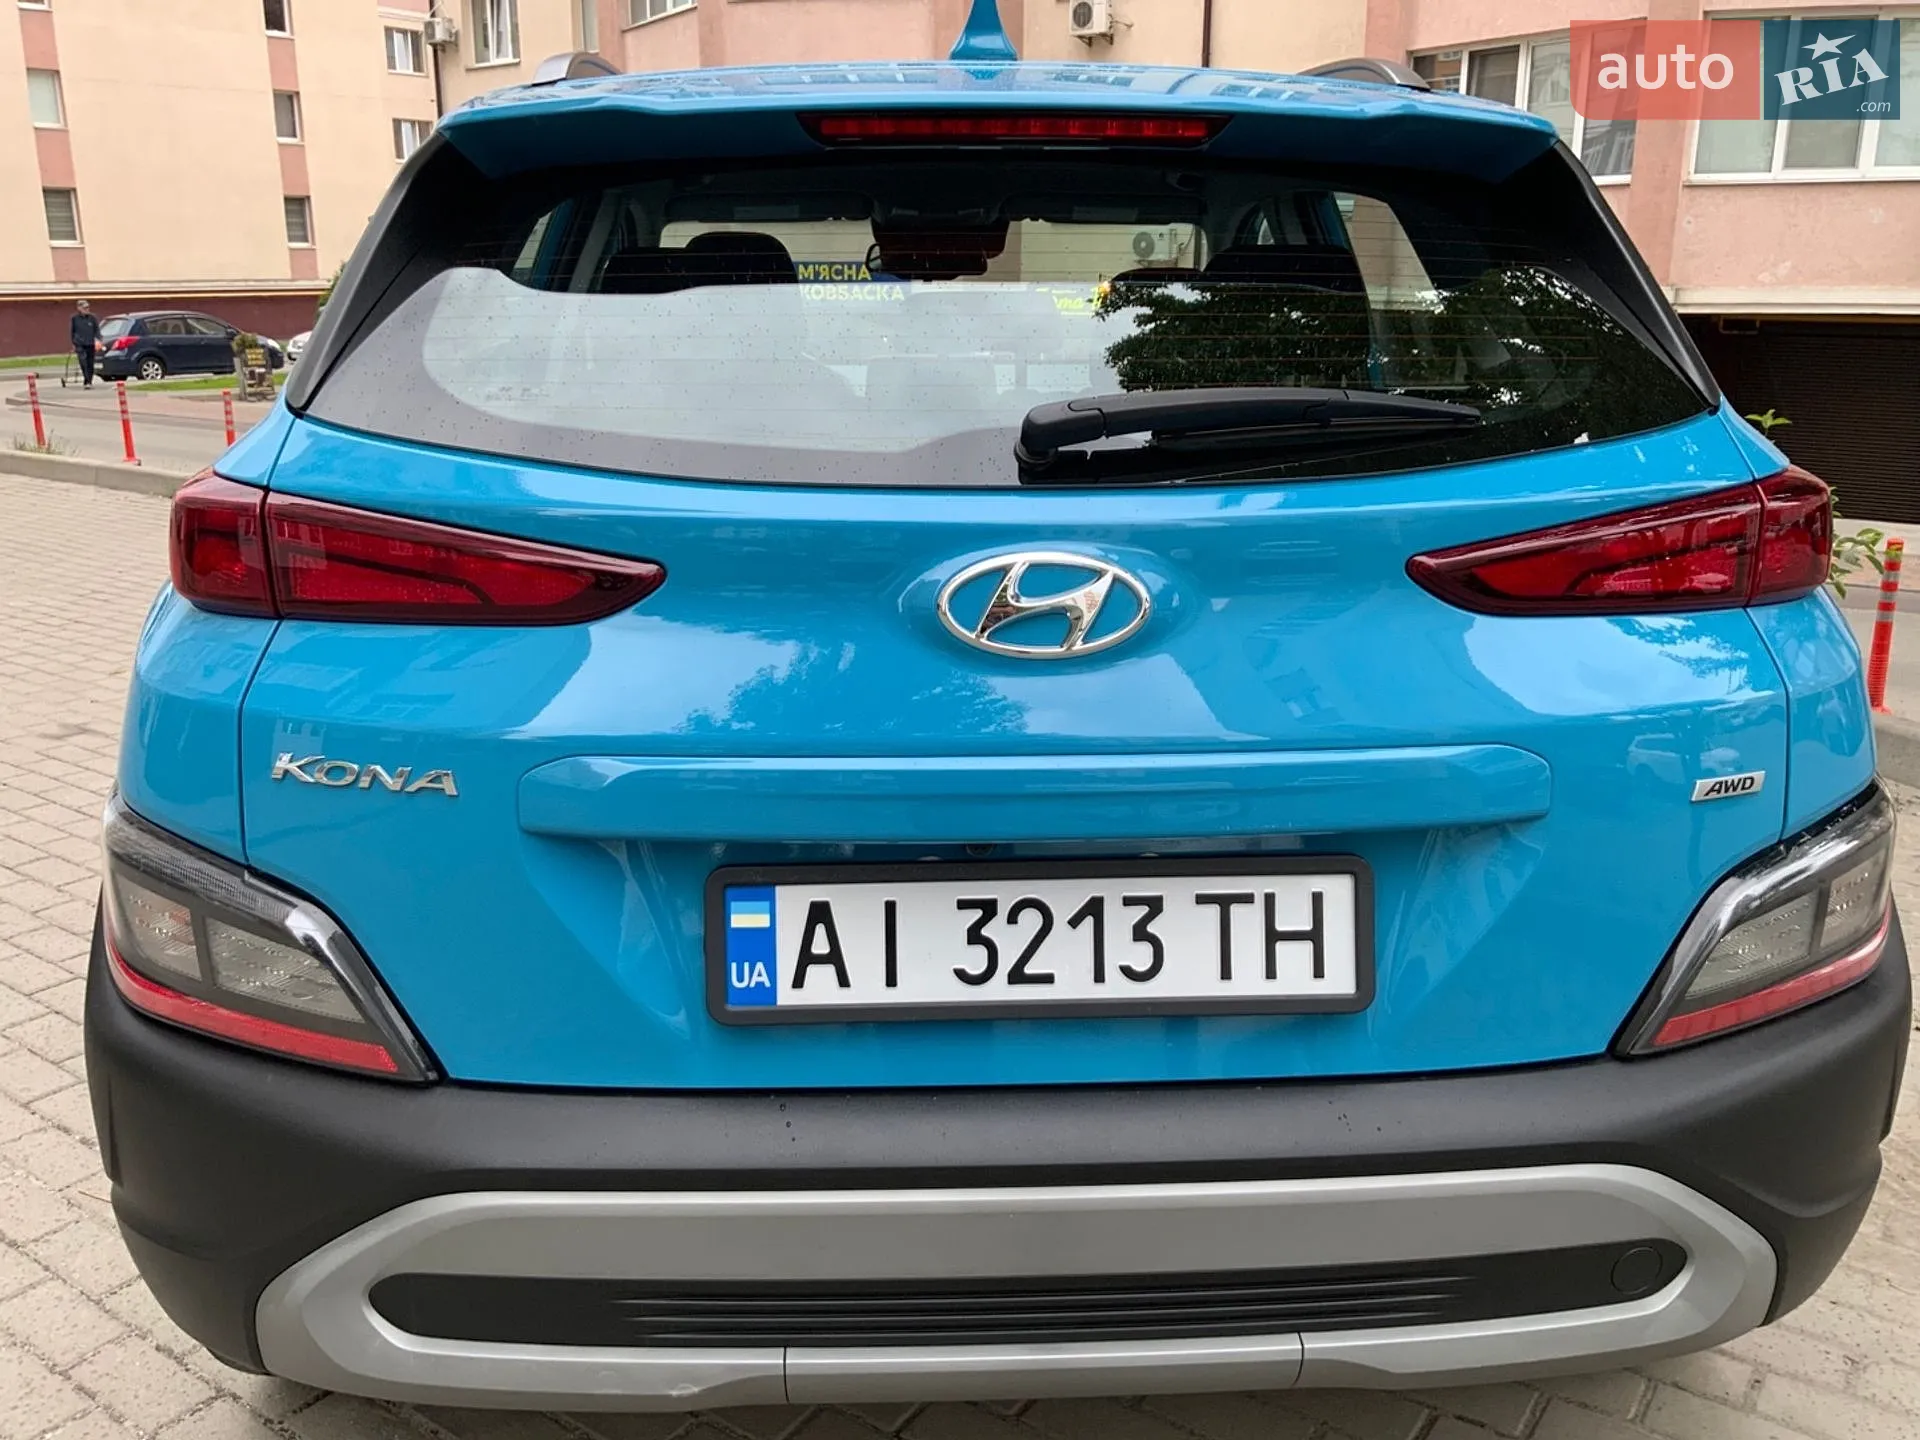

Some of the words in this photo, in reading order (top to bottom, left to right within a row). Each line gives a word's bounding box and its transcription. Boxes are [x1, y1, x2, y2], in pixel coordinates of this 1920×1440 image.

[798, 263, 872, 281] М'ЯСНА
[271, 752, 459, 797] KONA
[1703, 775, 1755, 797] AWD
[791, 898, 898, 990] AI
[952, 894, 1166, 987] 3213
[1195, 890, 1326, 981] TH
[730, 961, 771, 989] UA
